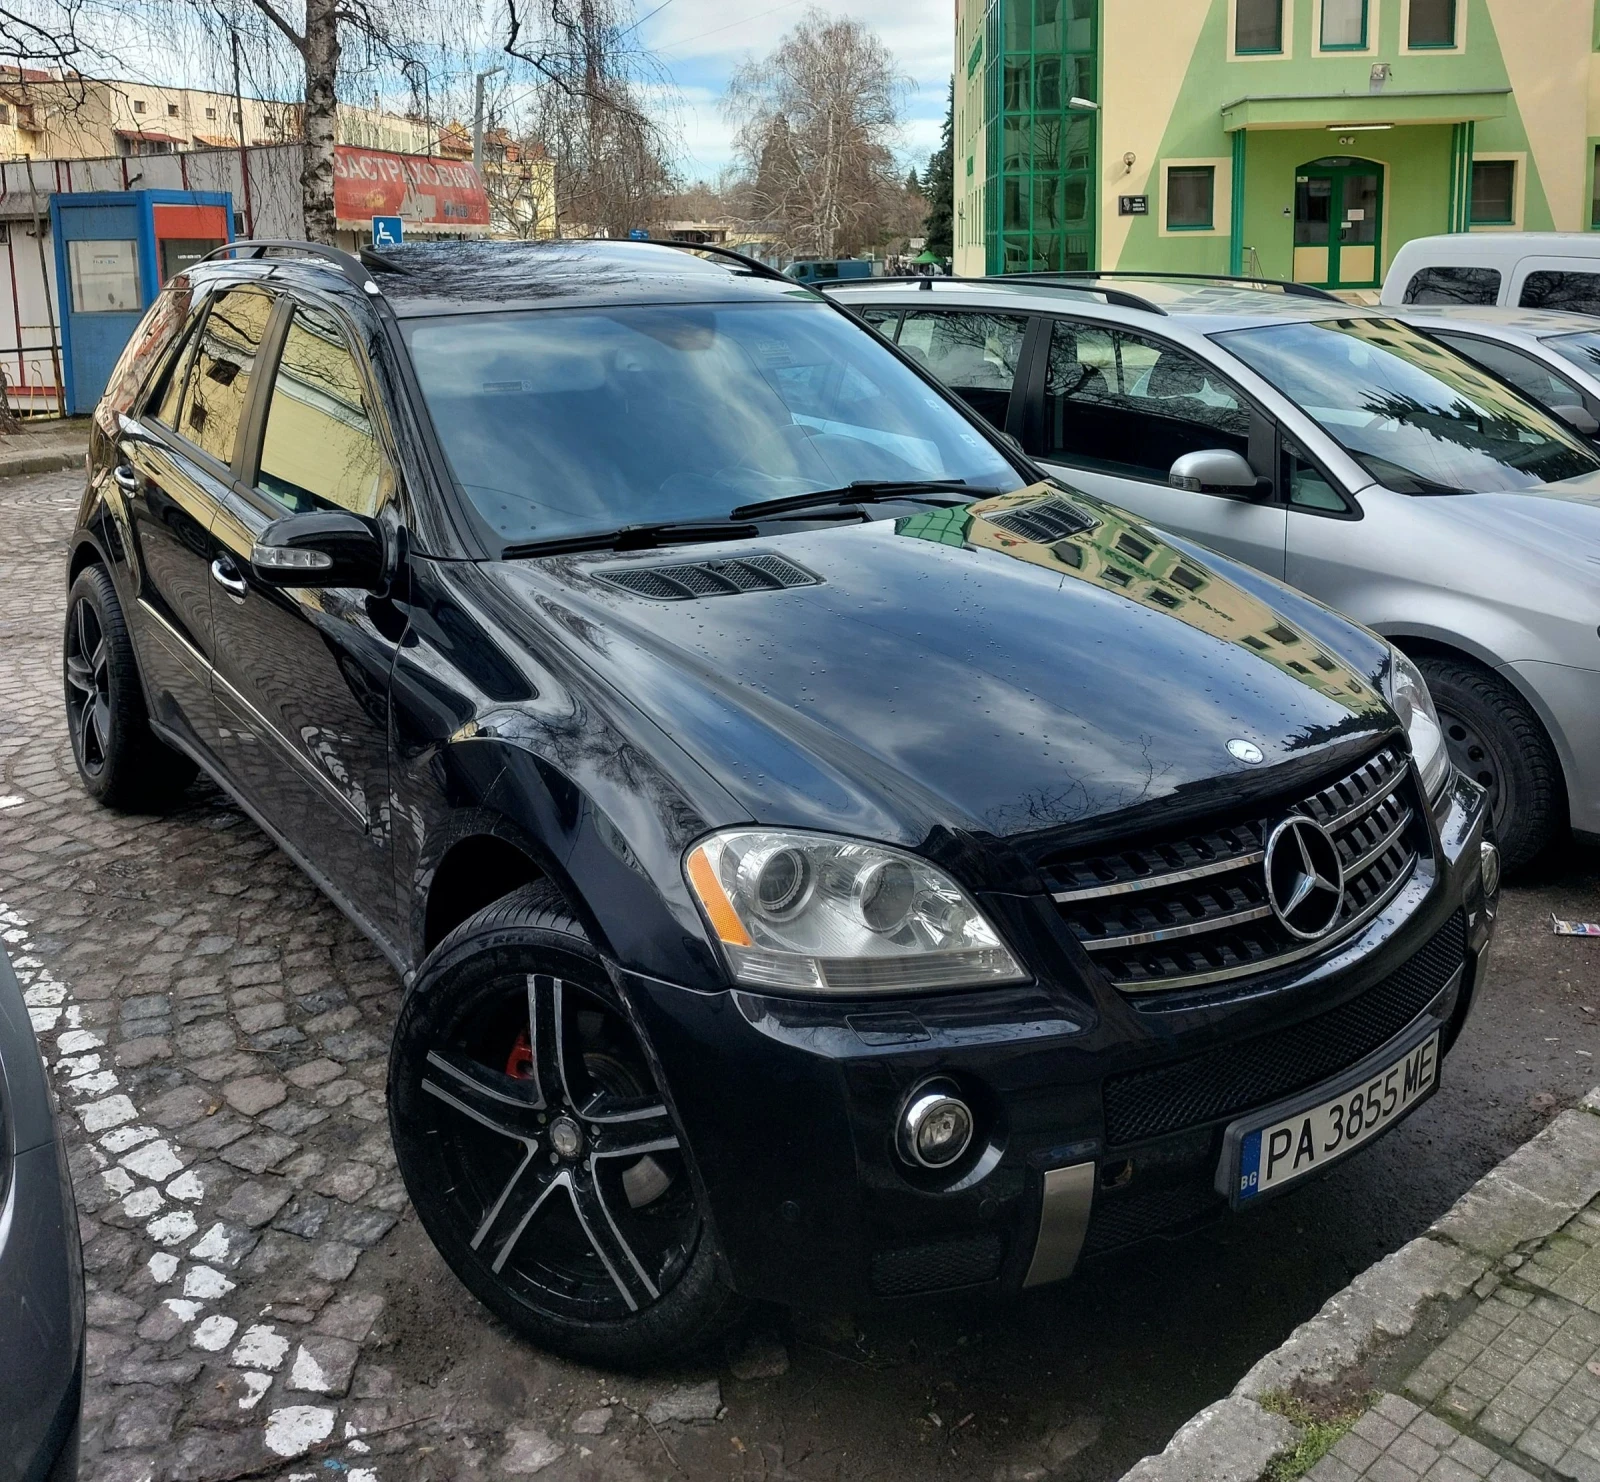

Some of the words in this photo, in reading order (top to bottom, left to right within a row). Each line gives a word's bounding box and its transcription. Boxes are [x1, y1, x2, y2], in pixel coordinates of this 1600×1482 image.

[334, 153, 477, 189] ЗАСТРАХОВКИ
[1266, 1117, 1315, 1181] PA
[1323, 1067, 1399, 1152] 3855
[1402, 1038, 1435, 1104] ME
[1240, 1171, 1257, 1190] BG
